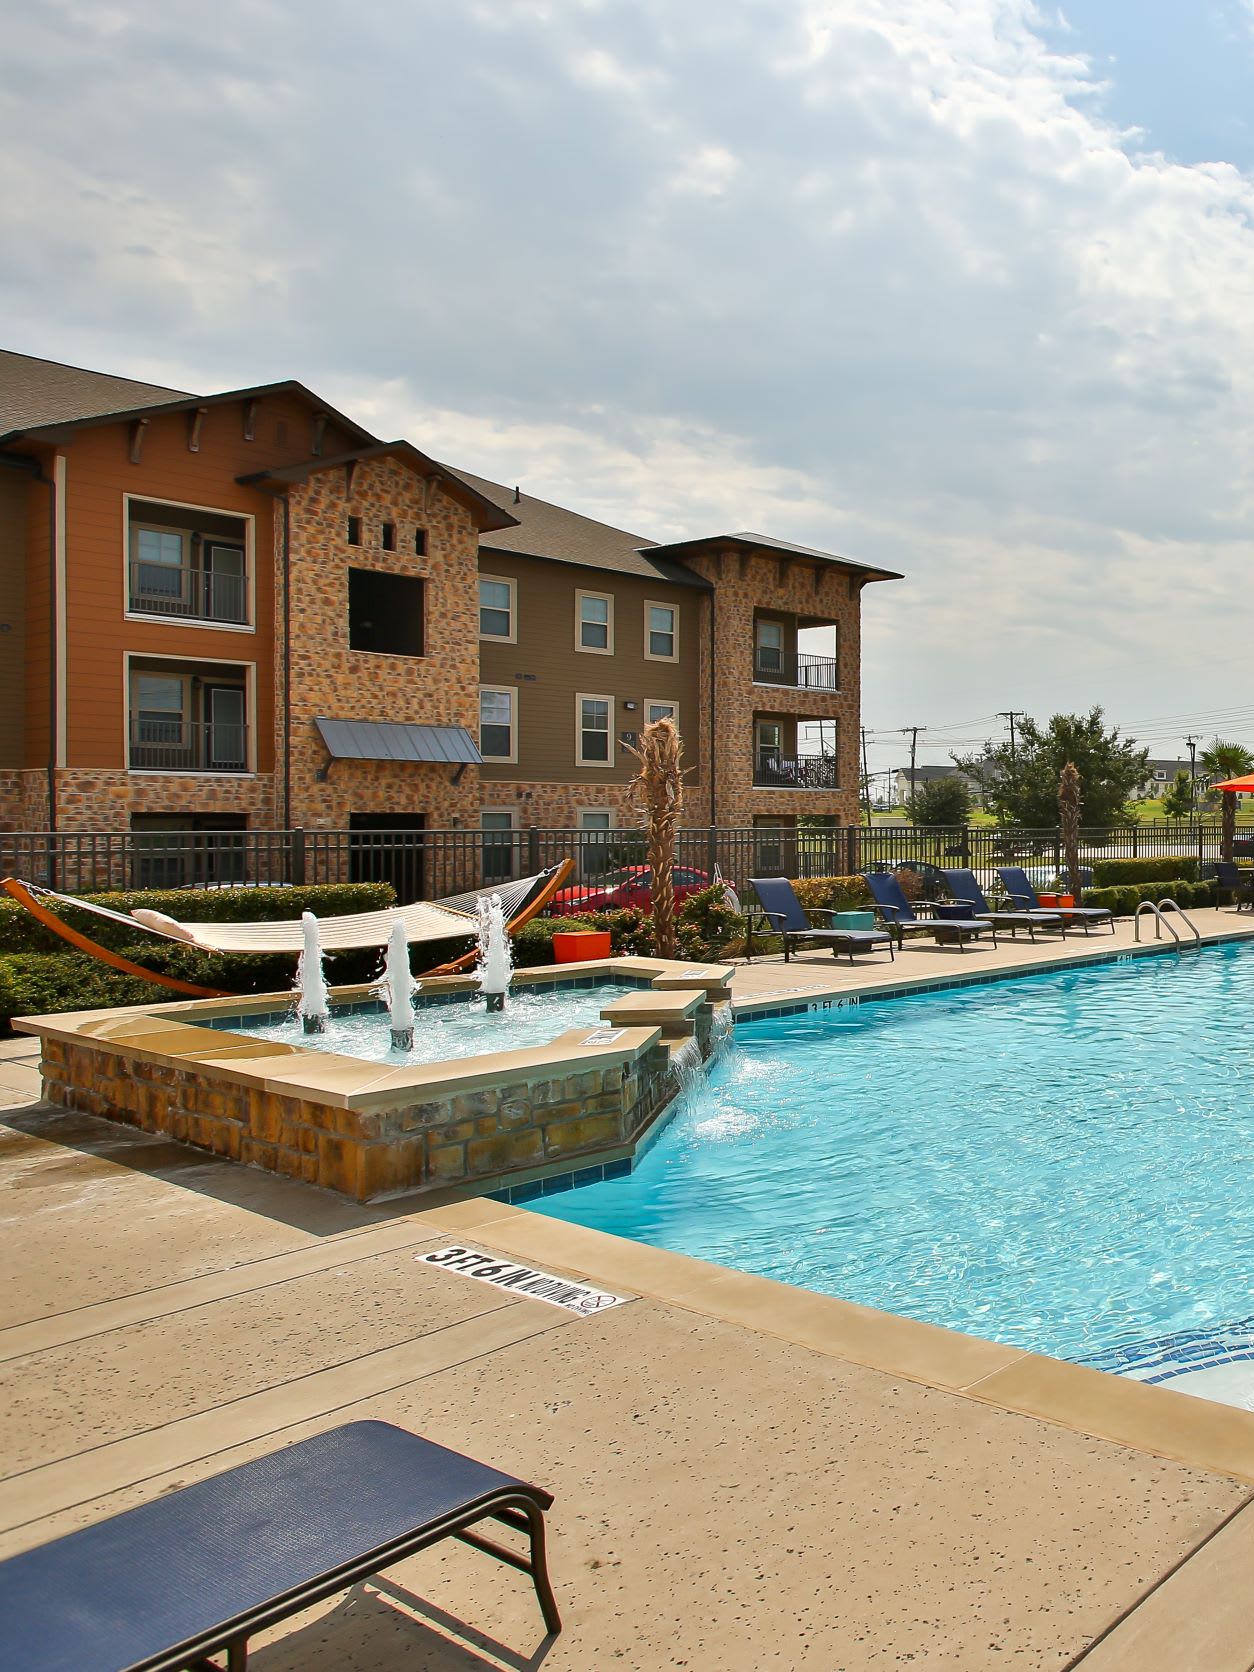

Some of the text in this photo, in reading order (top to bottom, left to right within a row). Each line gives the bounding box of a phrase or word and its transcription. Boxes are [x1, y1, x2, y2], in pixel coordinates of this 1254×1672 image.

[849, 997, 858, 1006] IN
[426, 1248, 466, 1263] 3
[470, 1264, 515, 1277] 6
[529, 1282, 592, 1304] DIVING
